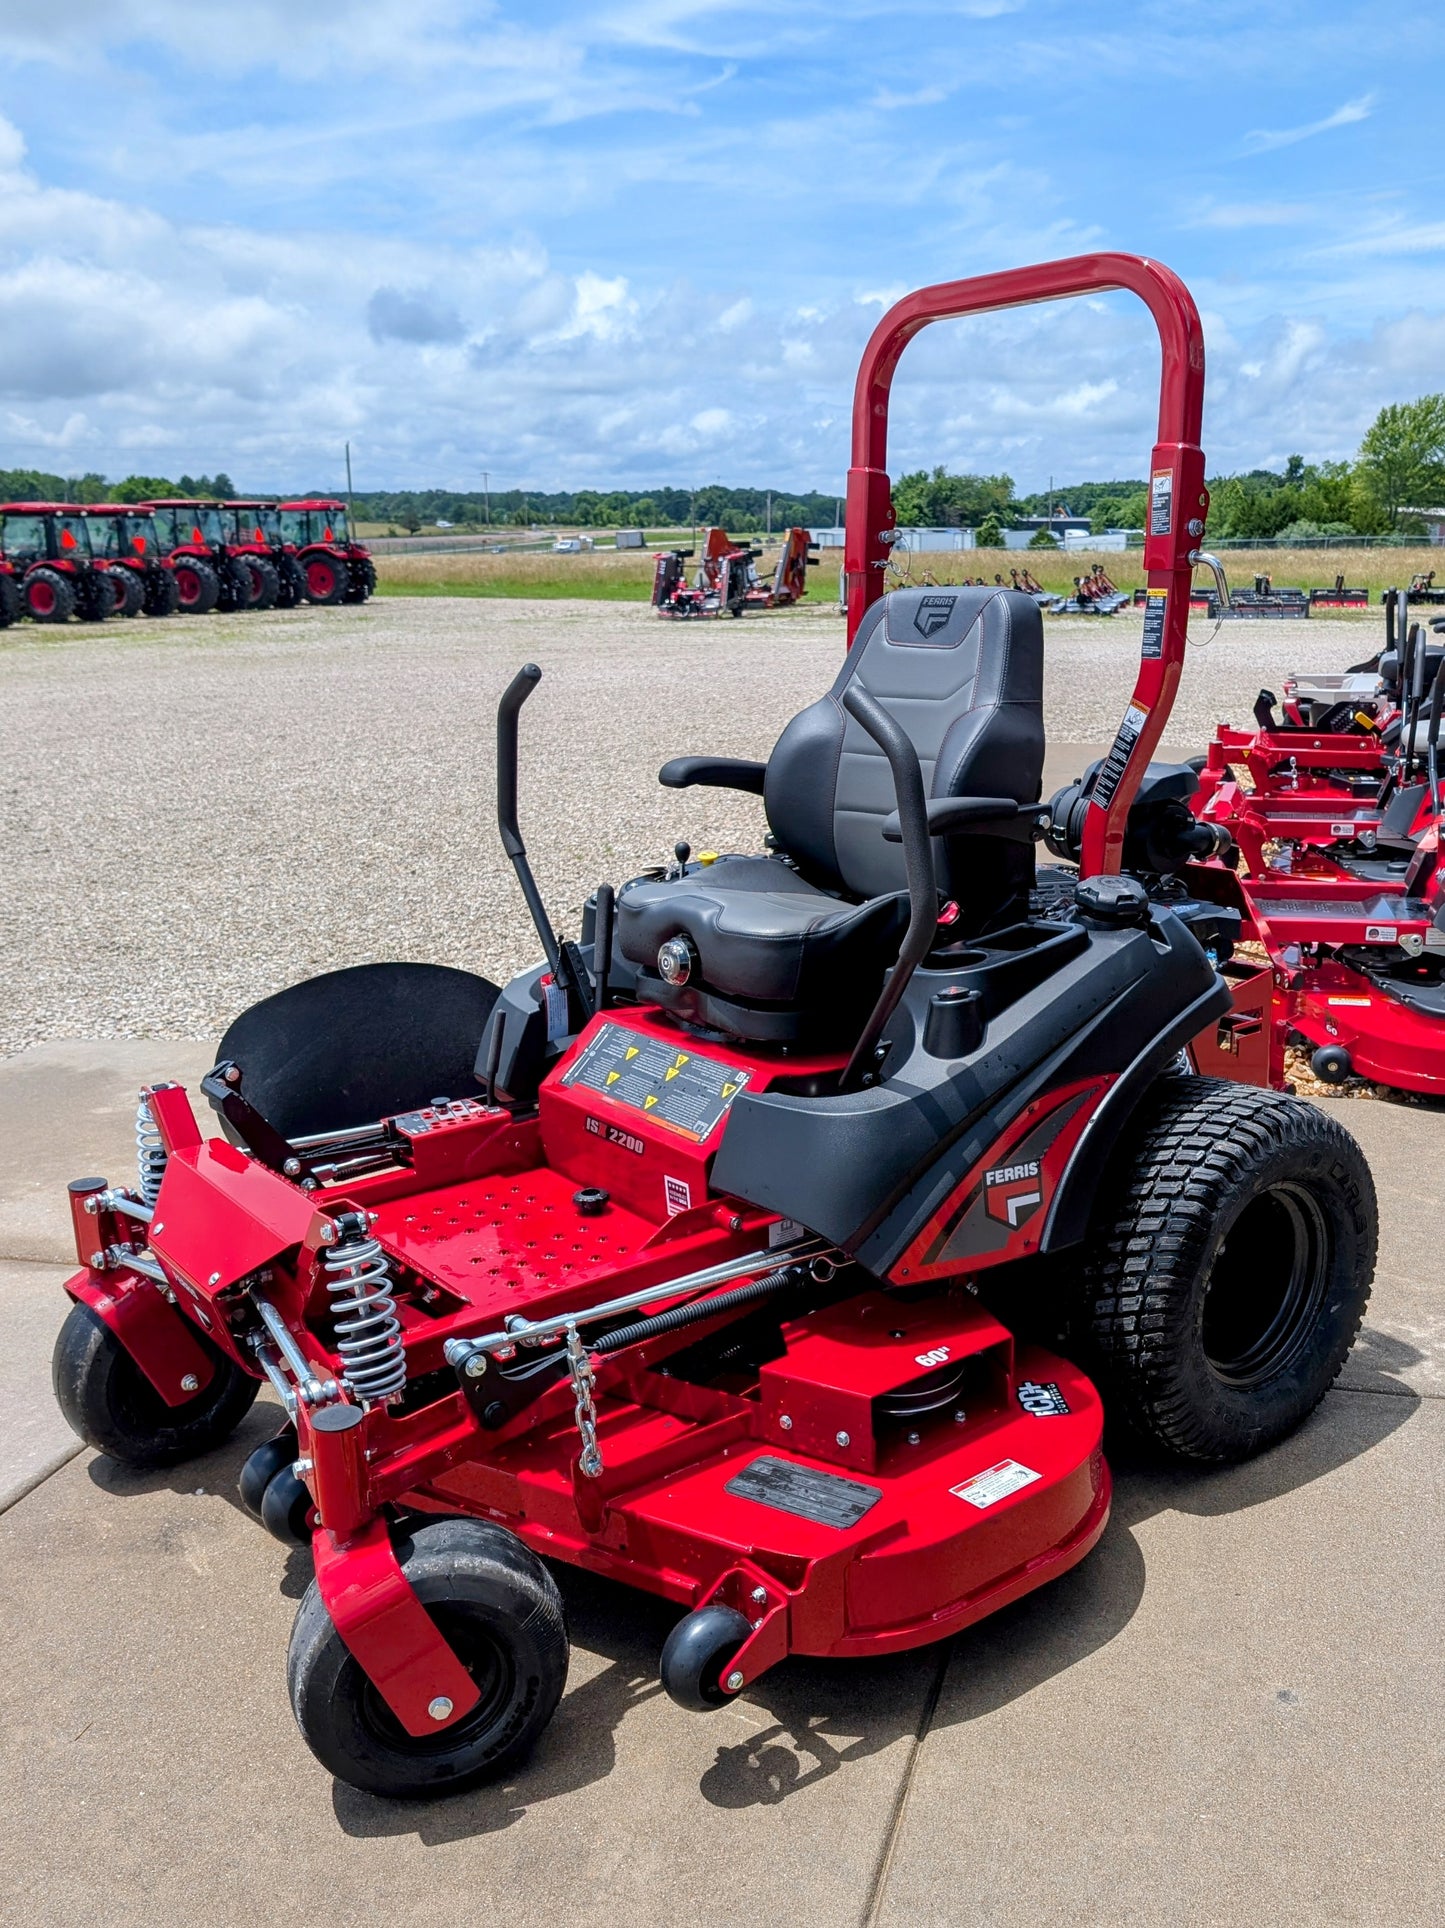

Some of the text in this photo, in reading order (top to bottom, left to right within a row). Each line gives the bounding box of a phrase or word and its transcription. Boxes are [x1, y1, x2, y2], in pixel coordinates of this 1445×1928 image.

[922, 597, 954, 606] FERRIS
[609, 1128, 644, 1154] 2200
[985, 1161, 1039, 1186] FERRIS
[914, 1346, 951, 1367] 60"
